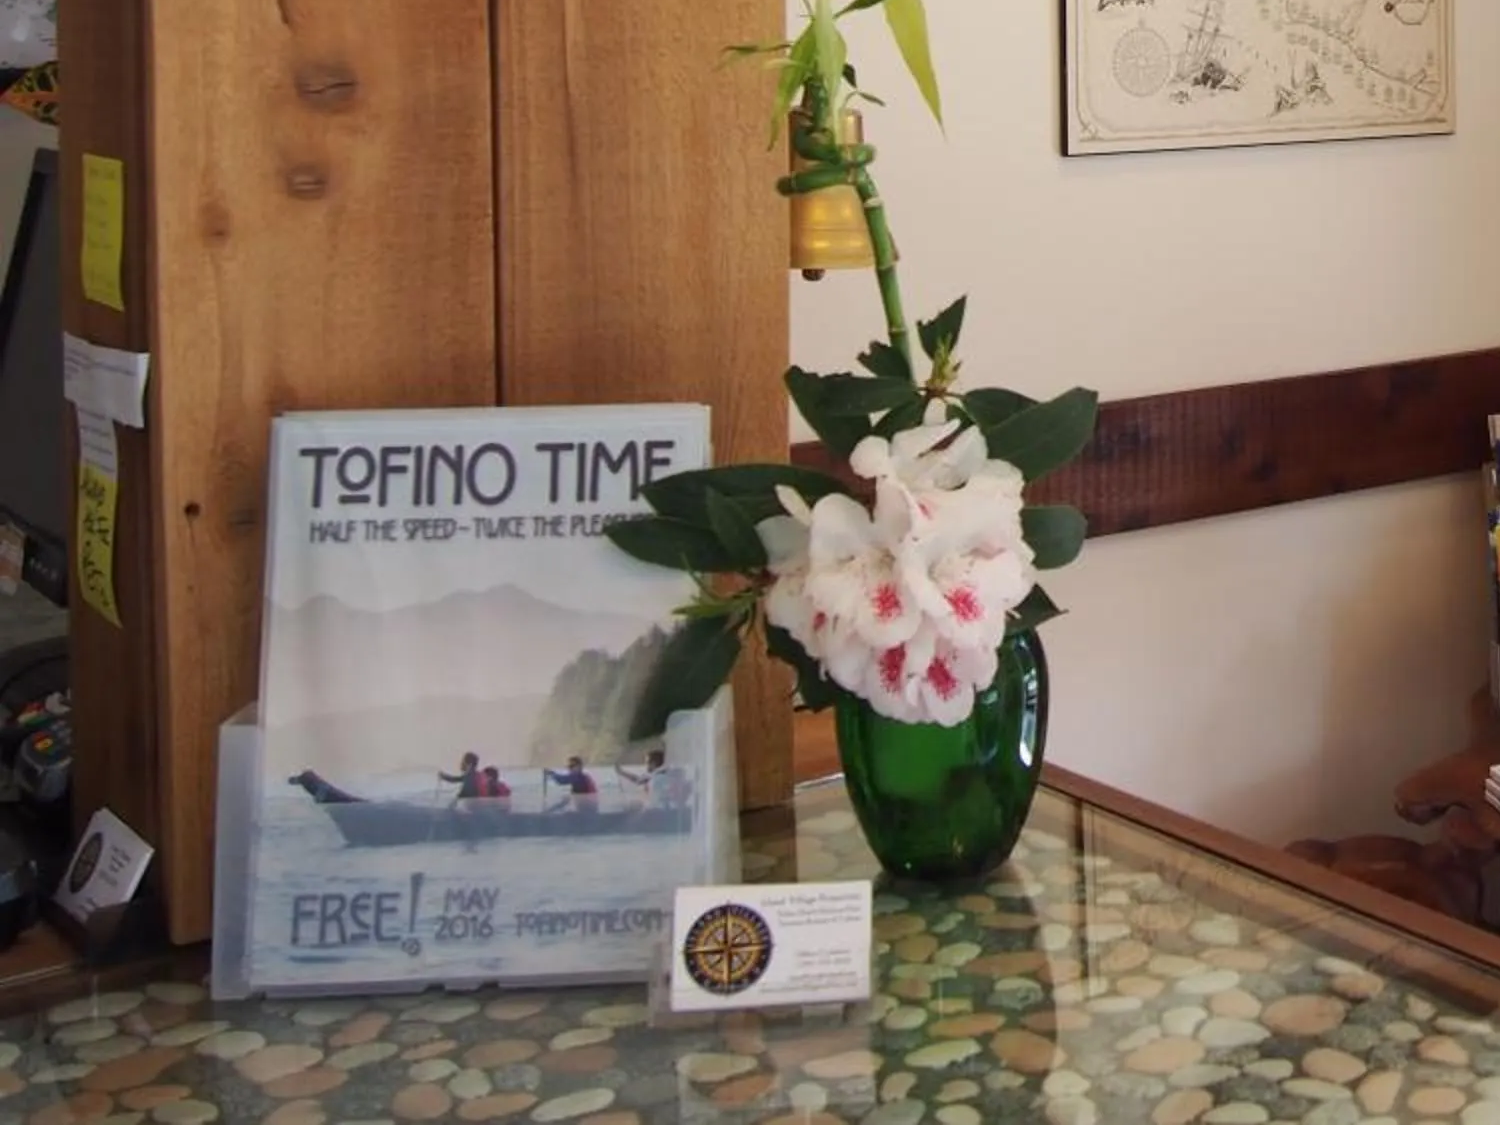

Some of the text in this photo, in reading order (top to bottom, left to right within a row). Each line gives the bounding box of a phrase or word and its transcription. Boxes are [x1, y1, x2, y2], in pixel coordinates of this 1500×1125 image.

[299, 441, 518, 509] TOFINO
[309, 519, 358, 543] HALF
[363, 518, 398, 542] THE
[532, 515, 566, 539] THE
[570, 512, 658, 538] PLEA
[444, 886, 499, 913] MAY
[433, 915, 495, 942] 2016
